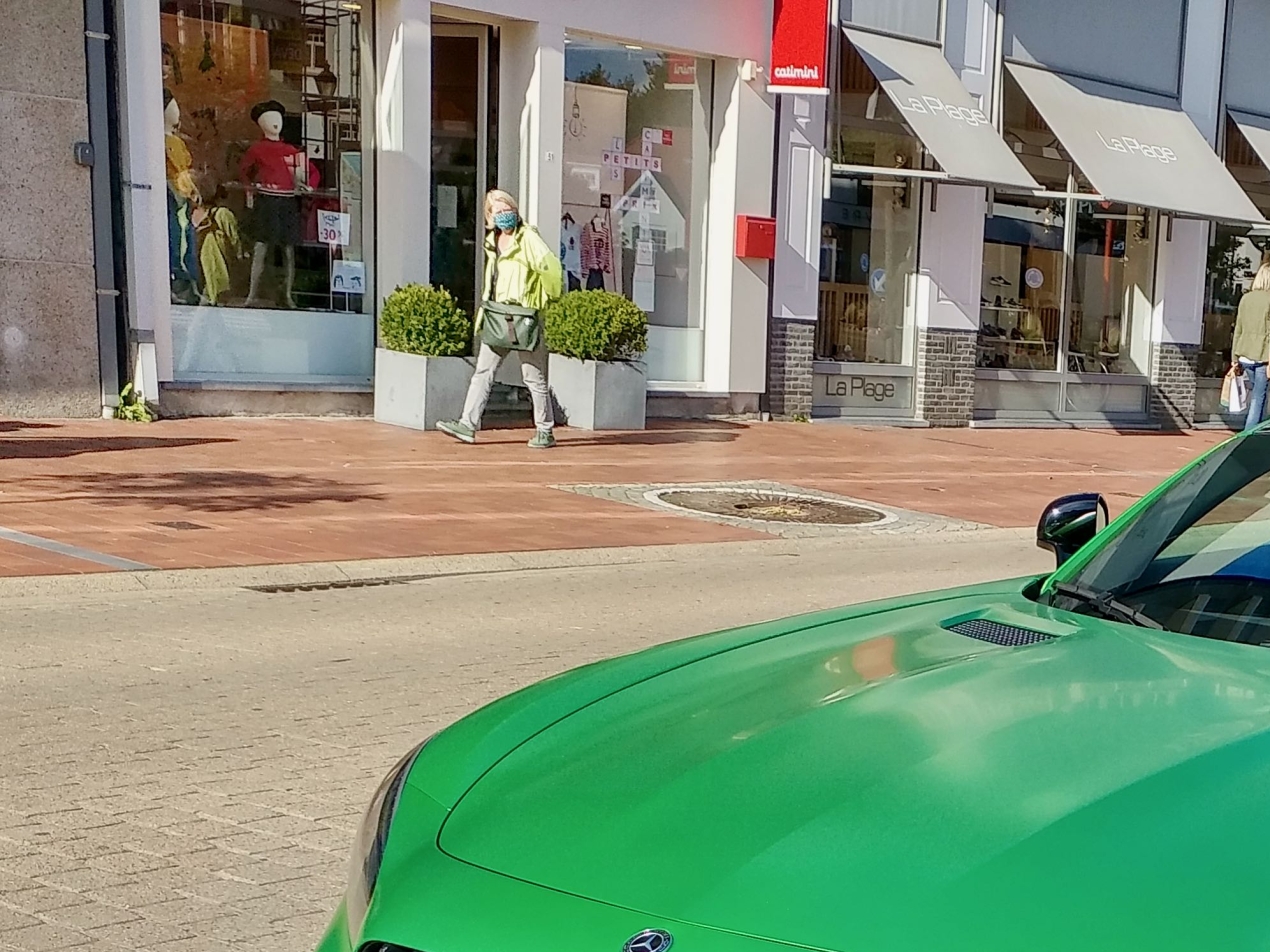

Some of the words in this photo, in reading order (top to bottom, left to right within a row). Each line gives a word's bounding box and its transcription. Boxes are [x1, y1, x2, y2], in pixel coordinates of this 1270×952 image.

[774, 65, 819, 80] catimini
[889, 89, 928, 114] La
[921, 95, 989, 127] Plage
[1096, 130, 1127, 152] La
[1122, 136, 1177, 164] Plage
[603, 153, 659, 169] PETITS
[825, 377, 847, 397] La
[850, 377, 895, 401] Plage
